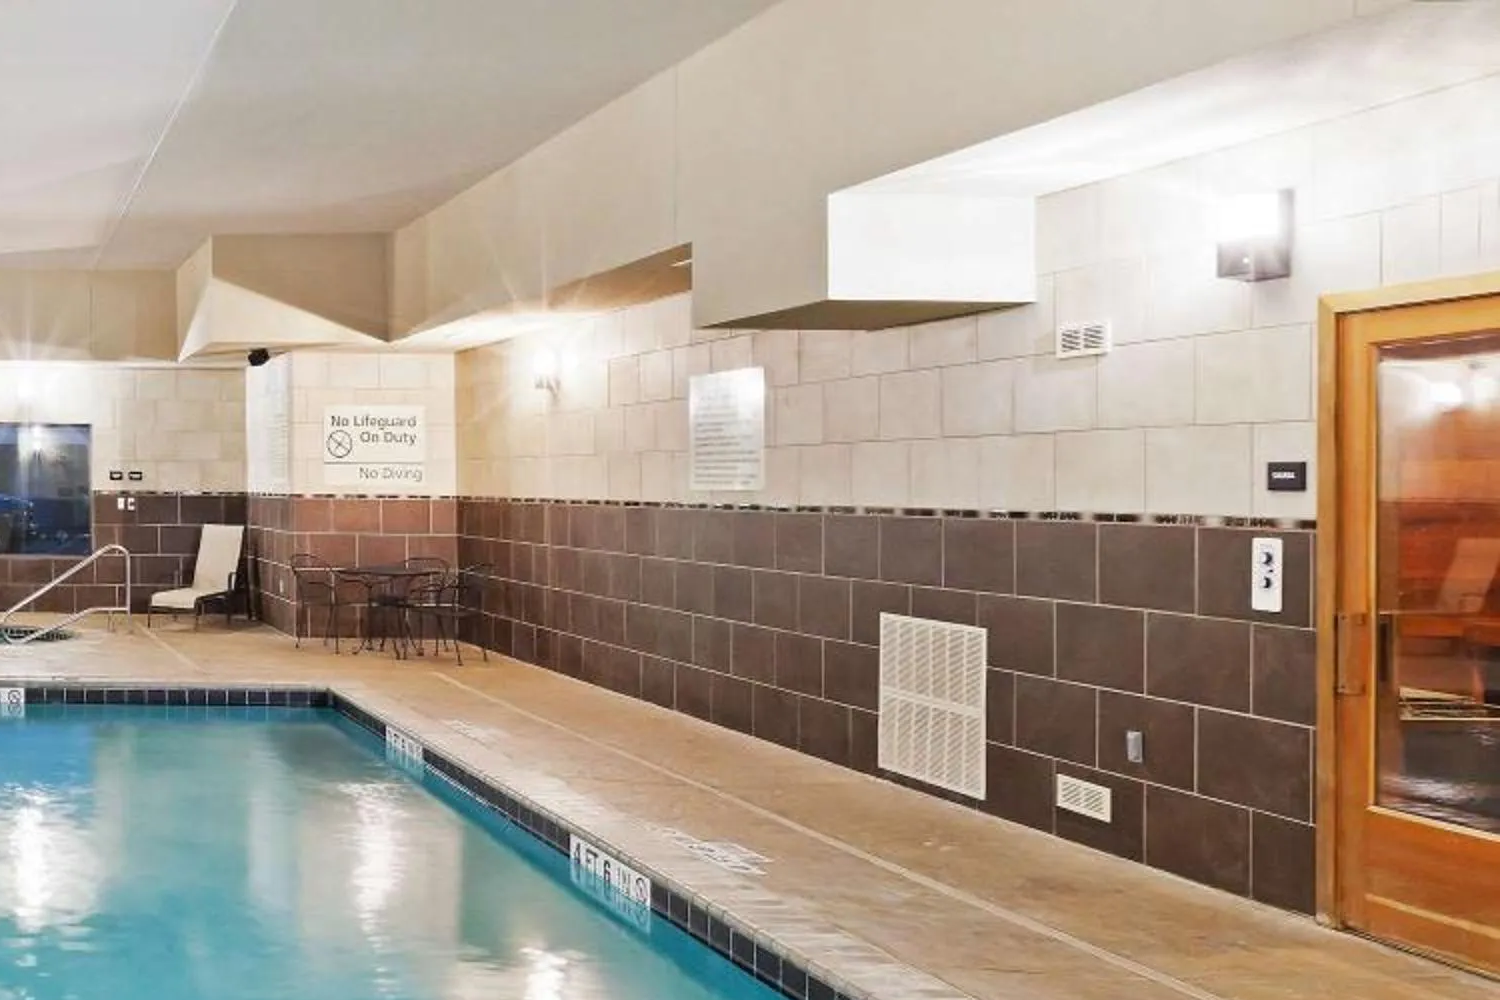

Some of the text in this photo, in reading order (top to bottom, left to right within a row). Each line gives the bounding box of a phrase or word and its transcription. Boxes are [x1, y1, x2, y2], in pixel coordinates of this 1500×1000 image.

[331, 415, 417, 430] No Lifeguard
[360, 431, 417, 446] On Duty
[359, 467, 422, 482] No Diving
